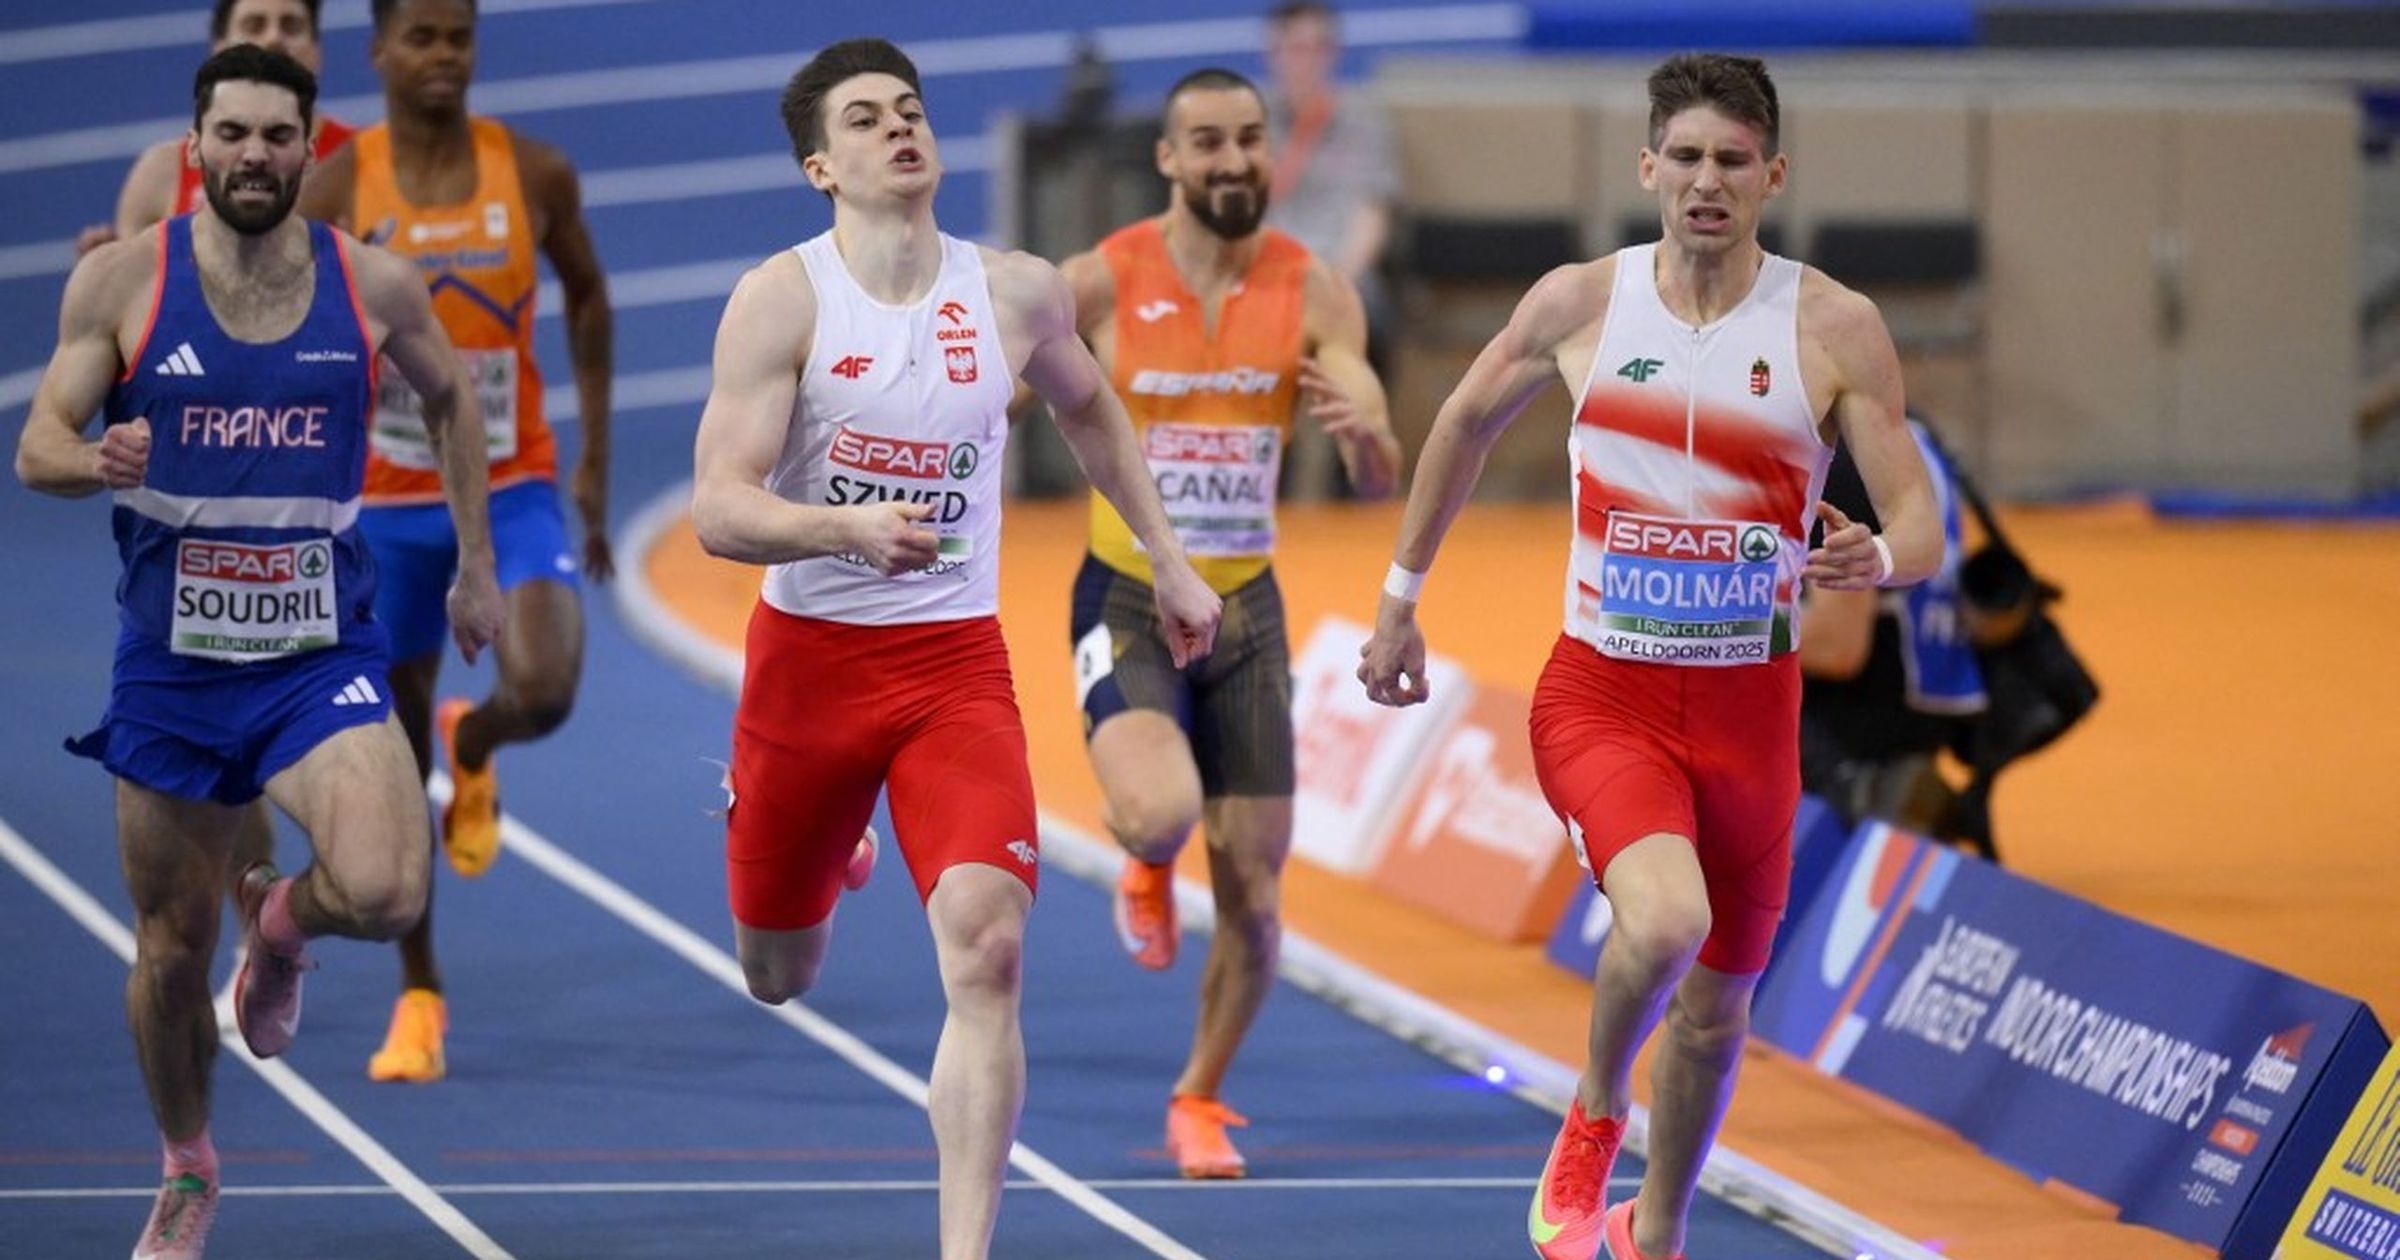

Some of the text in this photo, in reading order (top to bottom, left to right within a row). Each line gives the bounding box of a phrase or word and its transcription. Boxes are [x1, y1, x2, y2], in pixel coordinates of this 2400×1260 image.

[937, 329, 977, 341] ORLEN
[831, 355, 874, 379] 4F
[1130, 367, 1280, 396] ESPAÑA
[1617, 358, 1664, 382] 4F
[180, 406, 328, 447] FRANCE
[833, 433, 947, 475] SPAR
[1149, 429, 1248, 460] SPAR
[1157, 467, 1264, 503] CAÑAL
[1612, 522, 1733, 557] SPAR
[183, 546, 292, 578] SPAR
[1605, 564, 1771, 608] MOLNÁR
[177, 586, 331, 624] SOUDRIL
[1644, 620, 1679, 636] RUN
[214, 637, 247, 652] RUN
[1605, 635, 1764, 659] APELDOORN 2025
[1985, 974, 2232, 1131] INDOOR CHAMPIONSHIPS
